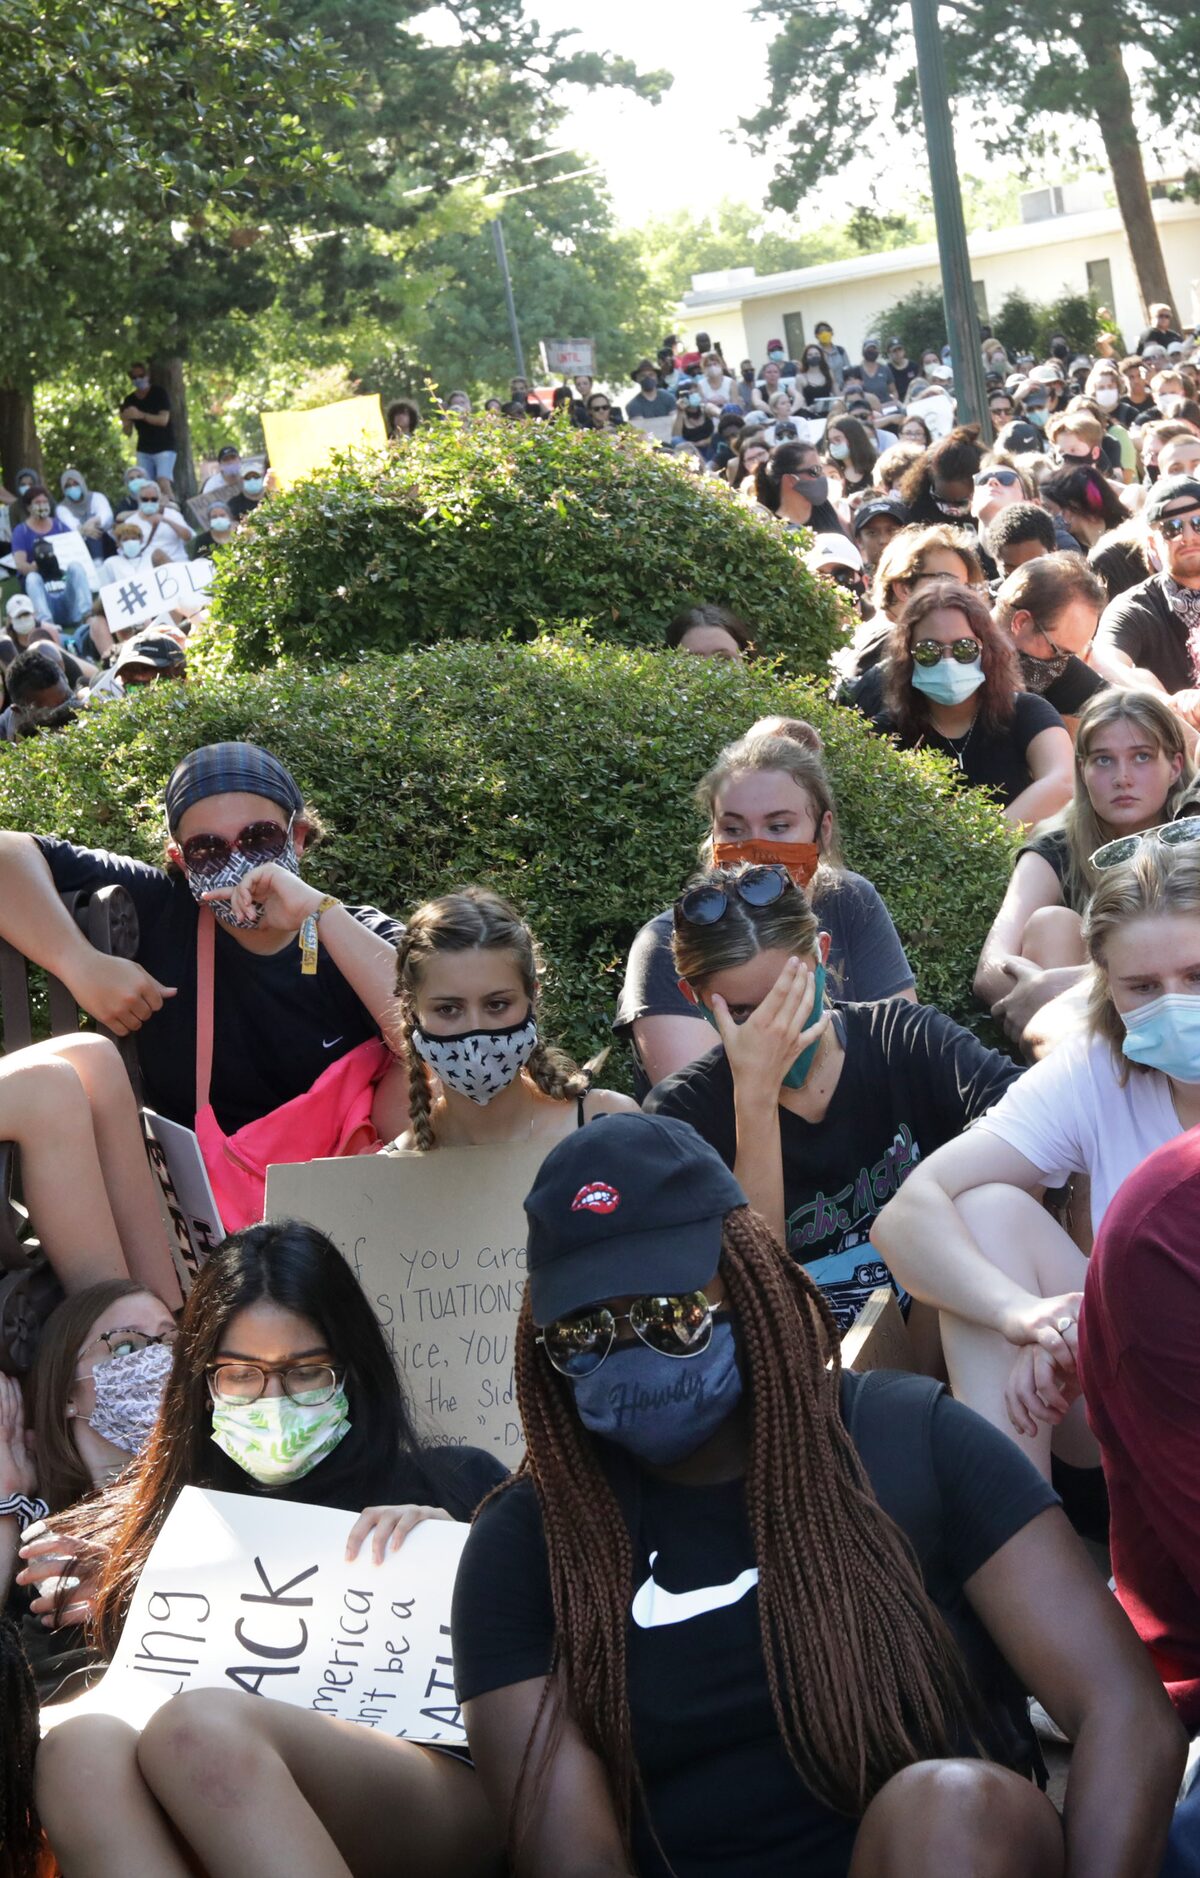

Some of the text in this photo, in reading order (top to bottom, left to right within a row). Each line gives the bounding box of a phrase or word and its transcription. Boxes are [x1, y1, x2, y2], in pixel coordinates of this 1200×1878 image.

[117, 564, 214, 615] #BL
[377, 1280, 525, 1327] SITUATIONS
[425, 1376, 458, 1415] the
[607, 1368, 708, 1428] Howdy
[225, 1556, 319, 1697] ACK
[390, 1598, 416, 1620] a
[126, 1591, 211, 1696] ing
[309, 1588, 374, 1717] merica
[374, 1636, 410, 1674] be
